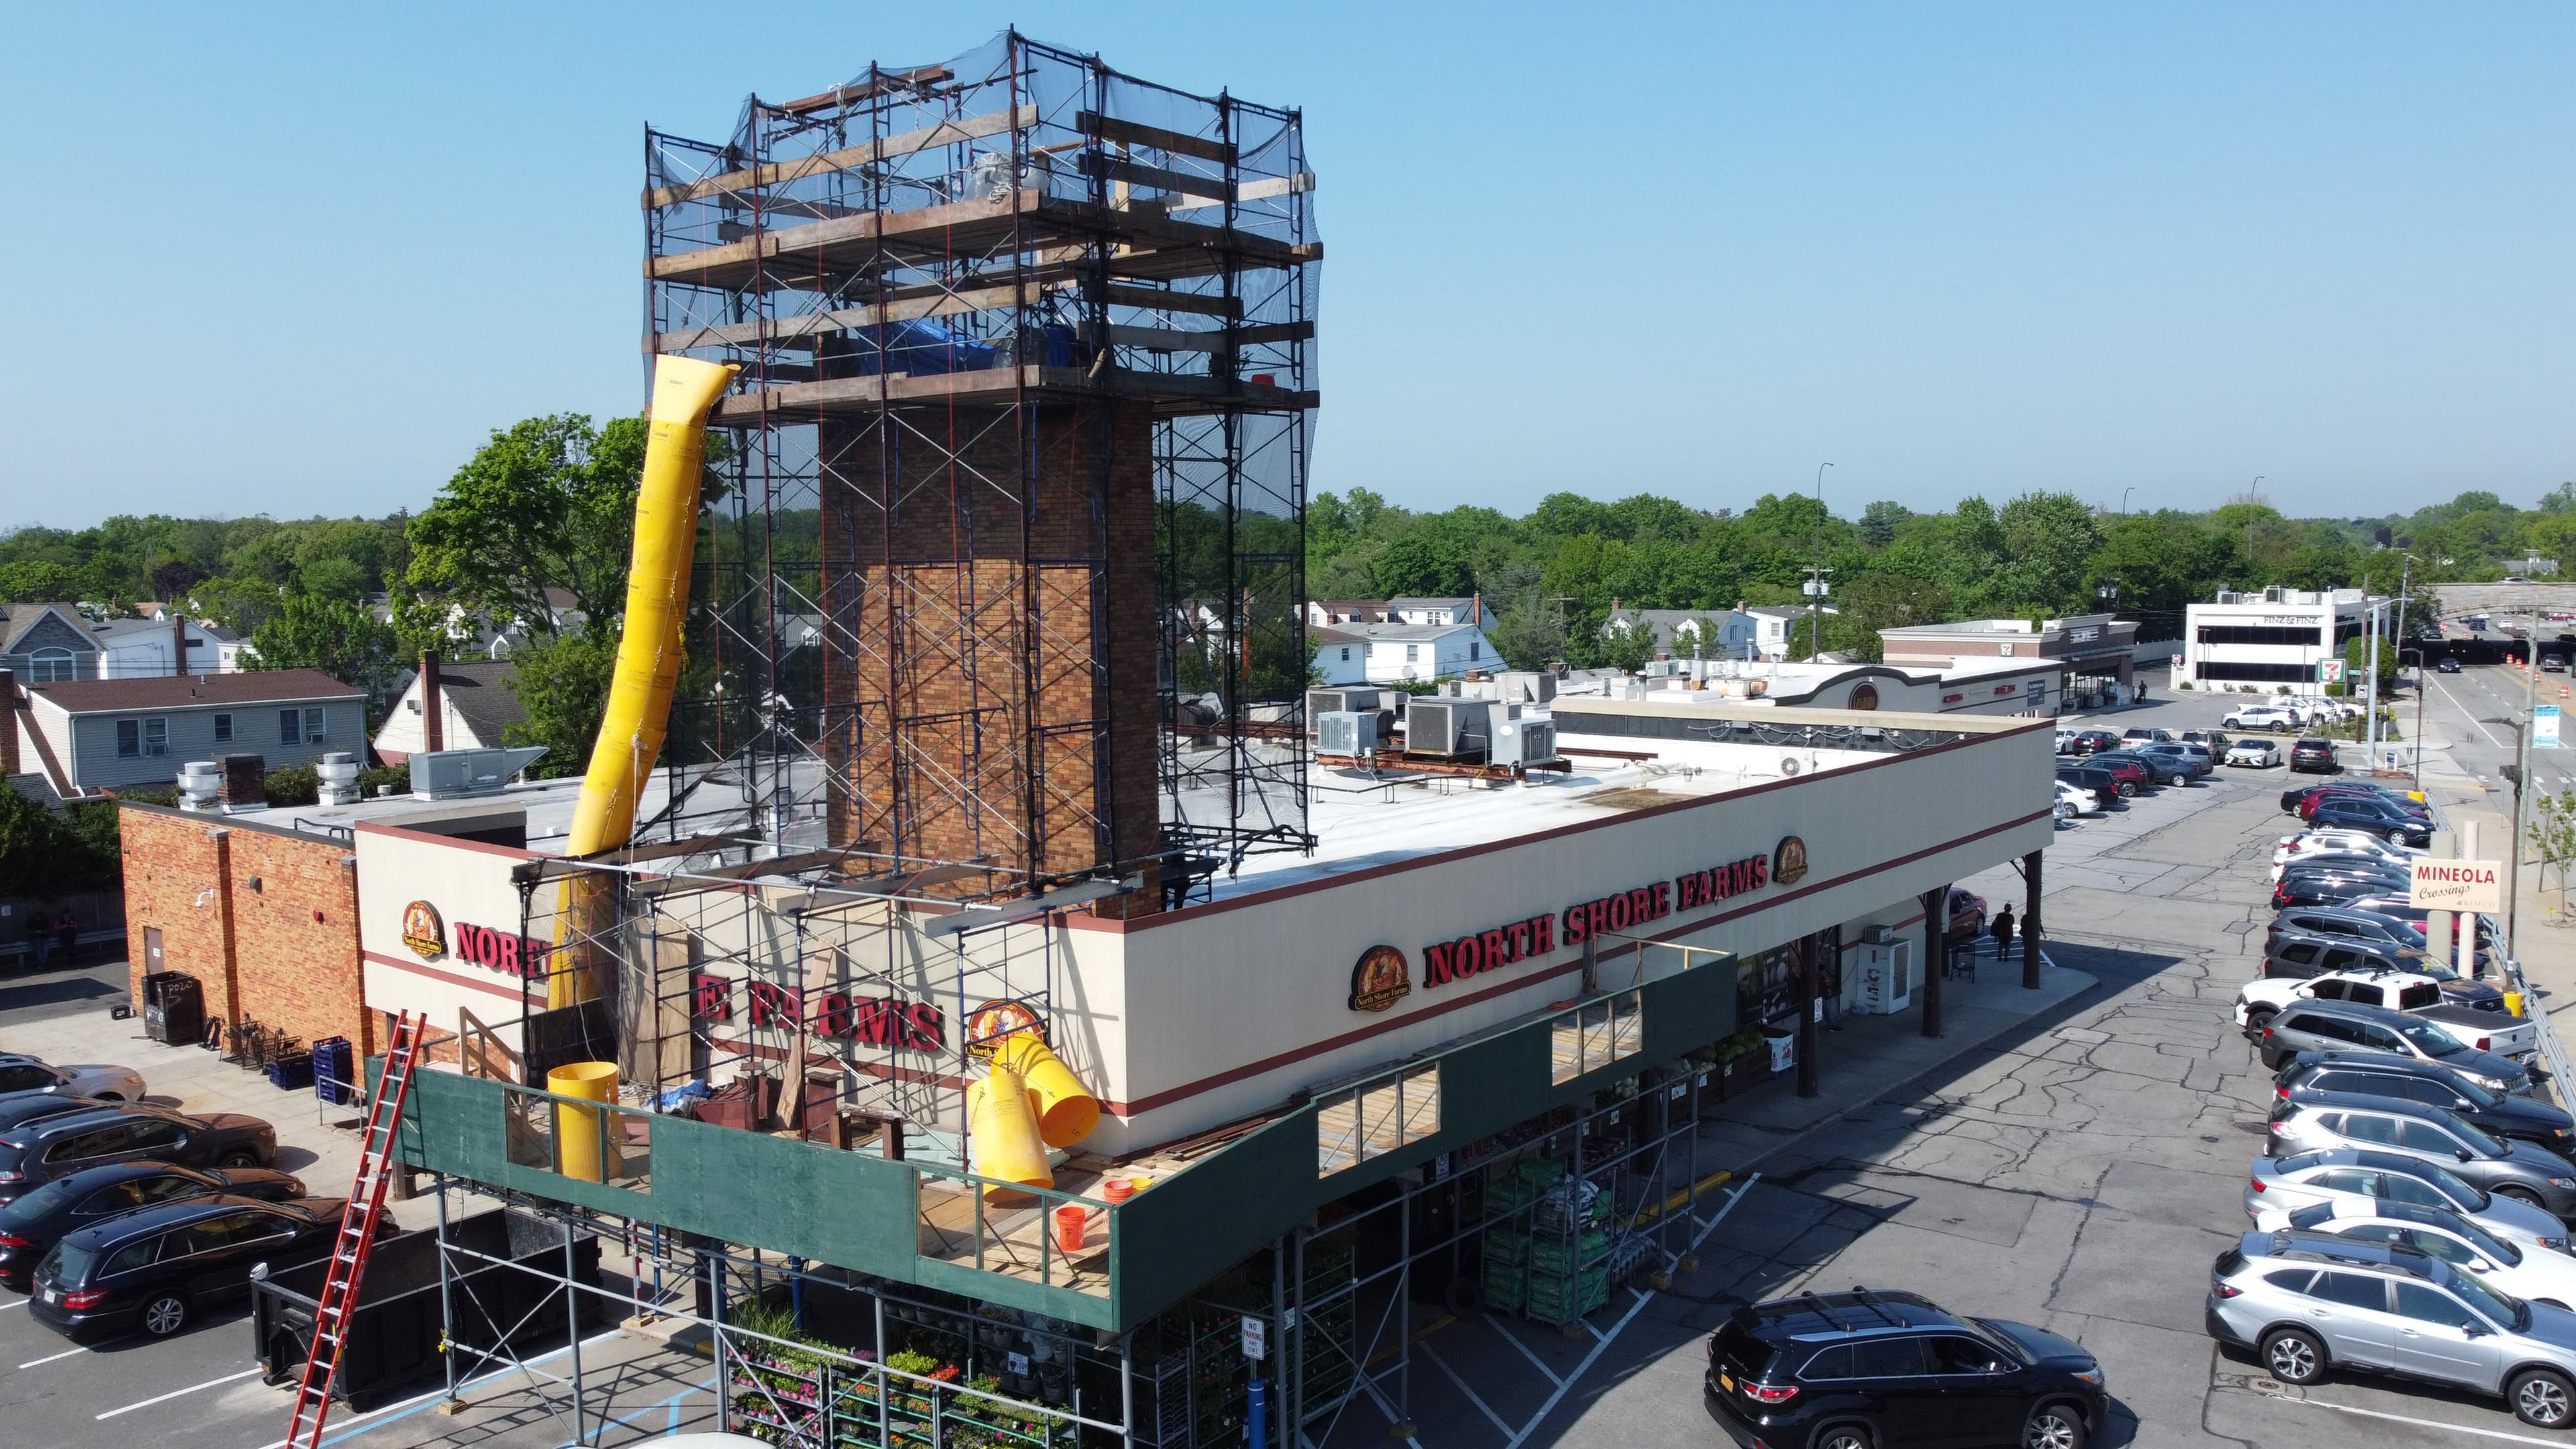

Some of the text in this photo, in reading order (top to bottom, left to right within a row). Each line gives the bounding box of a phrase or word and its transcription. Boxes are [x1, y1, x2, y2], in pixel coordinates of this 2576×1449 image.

[2264, 616, 2318, 625] FINZ & FINZ
[2418, 866, 2495, 883] MINEOLA
[2419, 884, 2470, 900] Crossings
[1424, 854, 1767, 988] NORTH SHORE FARMS
[1358, 994, 1374, 1005] North
[1375, 992, 1391, 1000] Shore
[749, 981, 946, 1052] FARMS
[969, 1046, 993, 1057] North
[1248, 1322, 1257, 1331] NO
[1244, 1330, 1263, 1341] PARKING
